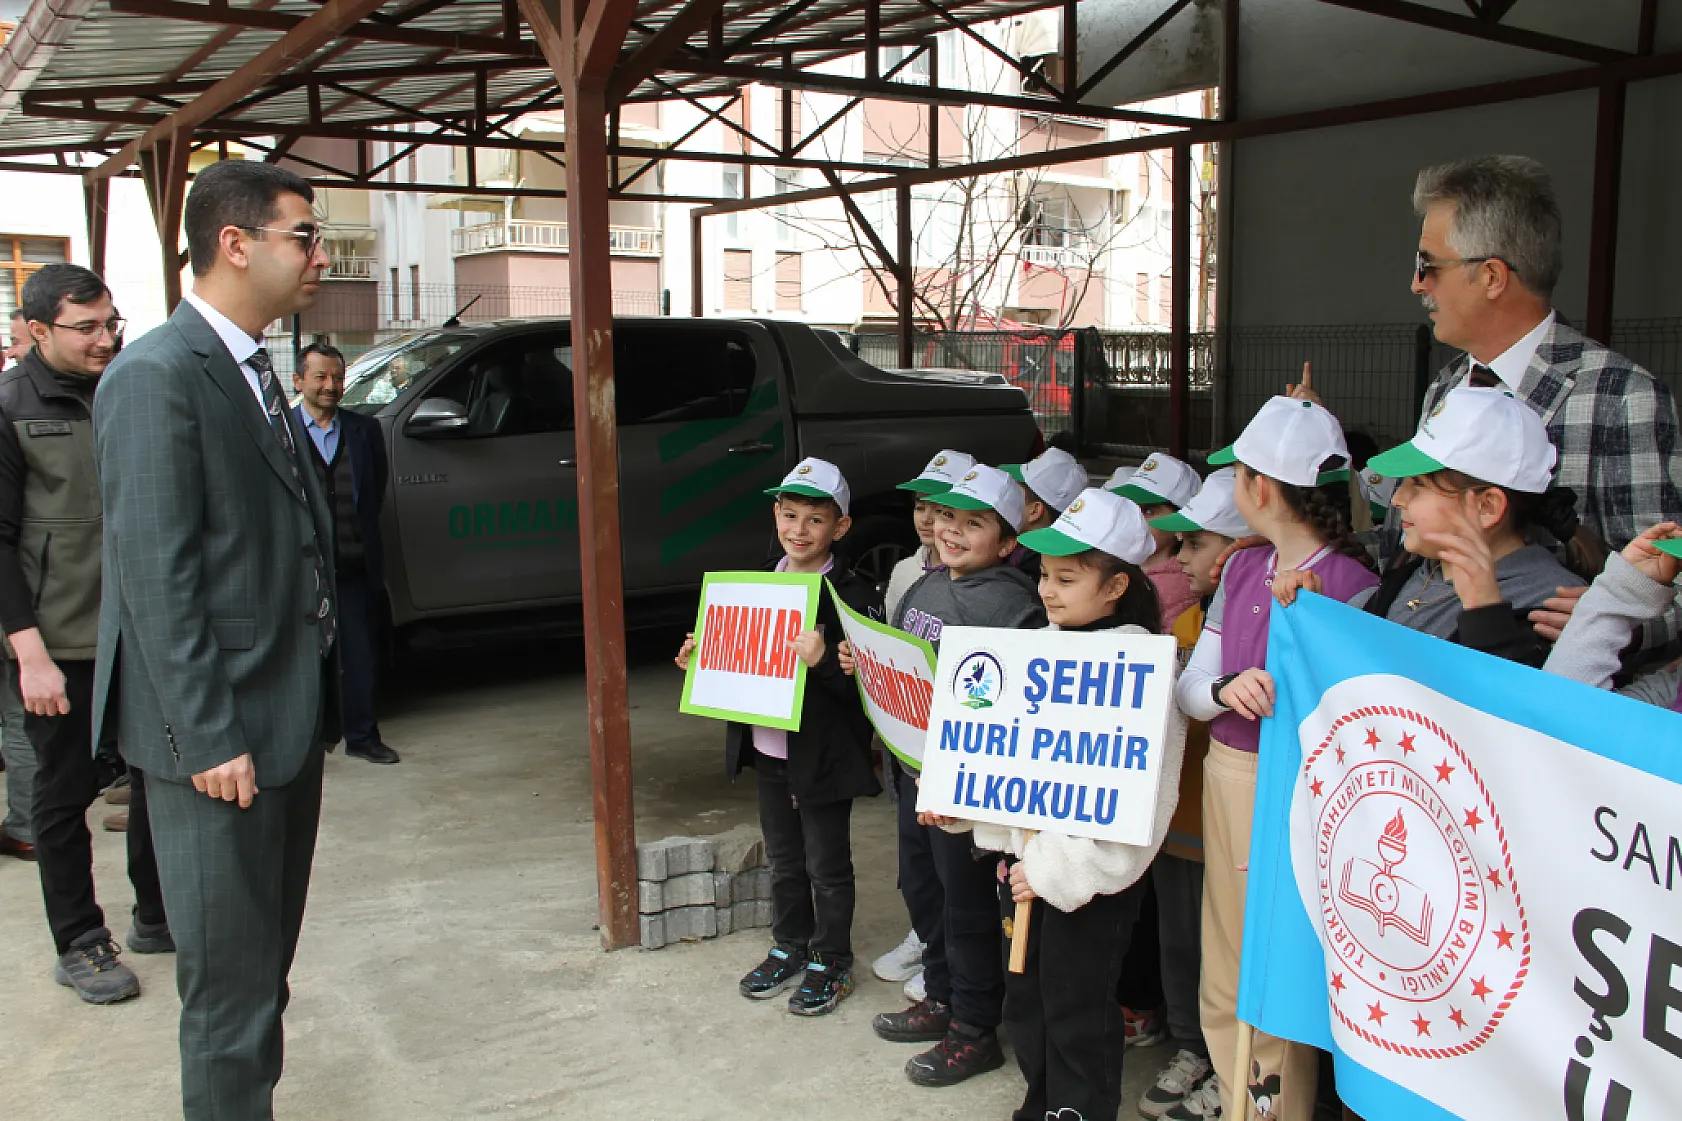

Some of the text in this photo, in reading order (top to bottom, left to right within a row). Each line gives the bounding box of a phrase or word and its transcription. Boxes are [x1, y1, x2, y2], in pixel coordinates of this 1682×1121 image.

[700, 604, 802, 679] ORMANLAR
[1024, 651, 1155, 715] ŞEHİT
[939, 717, 1150, 771] NURİ PAMİR
[953, 762, 1119, 826] İLKOKULU
[1318, 767, 1396, 869] CUMHURİYETİ
[1444, 822, 1480, 911] EĞİTİM
[1320, 878, 1365, 969] TÜRKİYE
[1400, 919, 1476, 996] BAKANLIĞI
